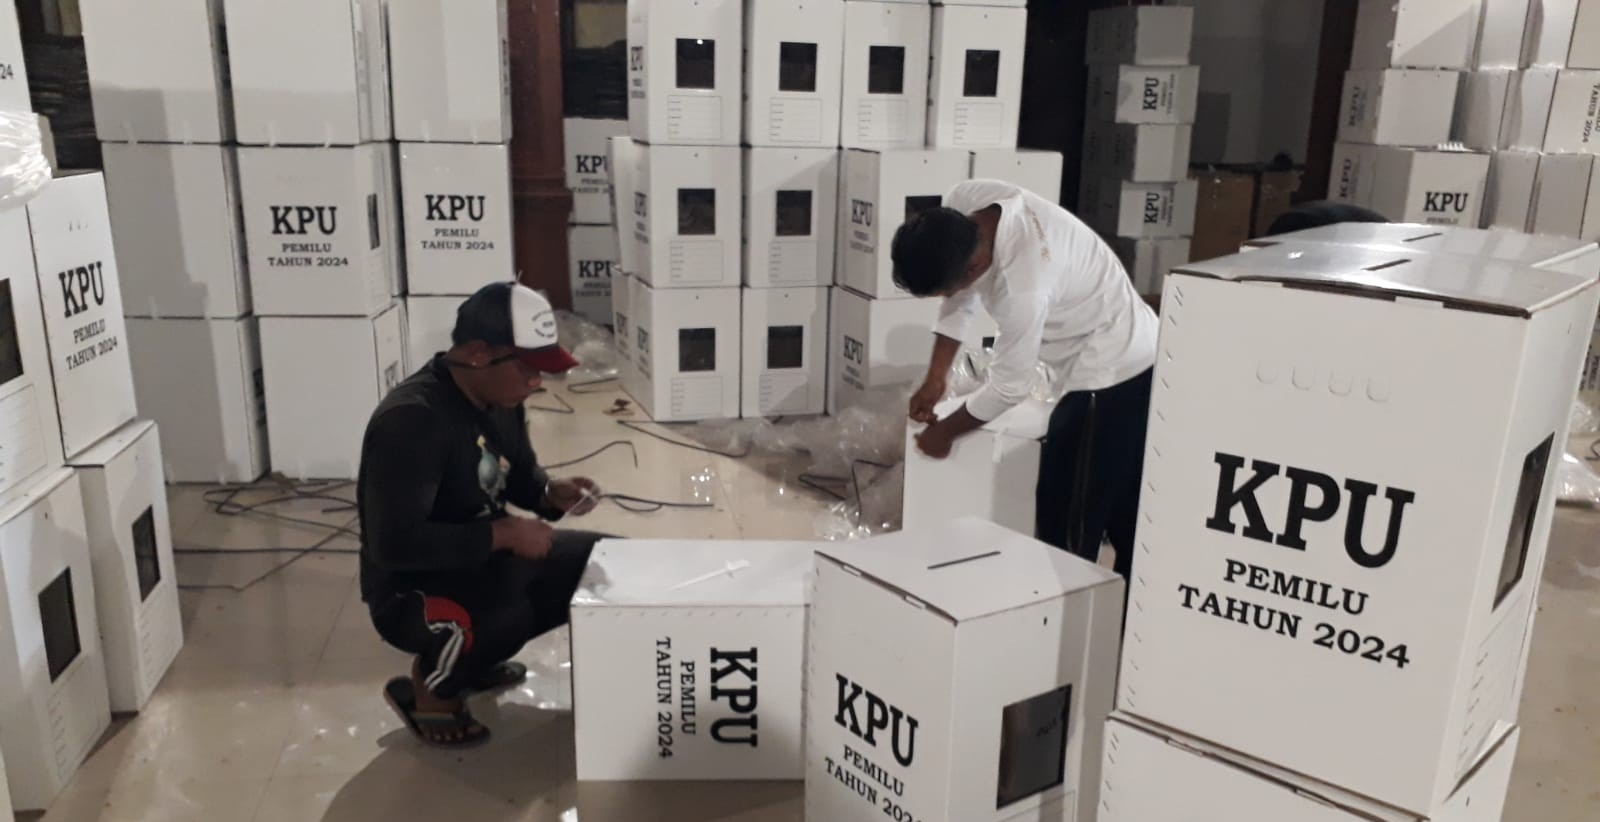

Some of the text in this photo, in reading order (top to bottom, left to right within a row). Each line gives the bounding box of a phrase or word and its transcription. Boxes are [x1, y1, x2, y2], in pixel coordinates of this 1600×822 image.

[1142, 77, 1160, 110] KPU
[423, 194, 486, 221] KPU
[851, 199, 873, 227] KPU
[1145, 192, 1160, 224] KPU
[1423, 191, 1469, 213] KPU
[270, 206, 337, 235] KPU
[434, 228, 480, 238] PEMILU
[281, 243, 332, 253] PEMILU
[421, 240, 495, 250] TAHUN 2024
[268, 257, 349, 267] TAHUN 2024
[58, 261, 105, 318] KPU
[73, 319, 106, 344] PEMILU
[66, 345, 97, 370] TAHUN
[844, 335, 863, 365] KPU
[1206, 451, 1415, 568] KPU
[1223, 558, 1369, 615] PEMILU
[1178, 583, 1410, 669] TAHUN 2024
[656, 636, 673, 759] TAHUN 2024
[680, 660, 696, 735] PEMILU
[710, 647, 758, 748] KPU
[834, 672, 919, 768] KPU
[843, 744, 904, 797] PEMILU
[824, 756, 921, 822] TAHUN 202
